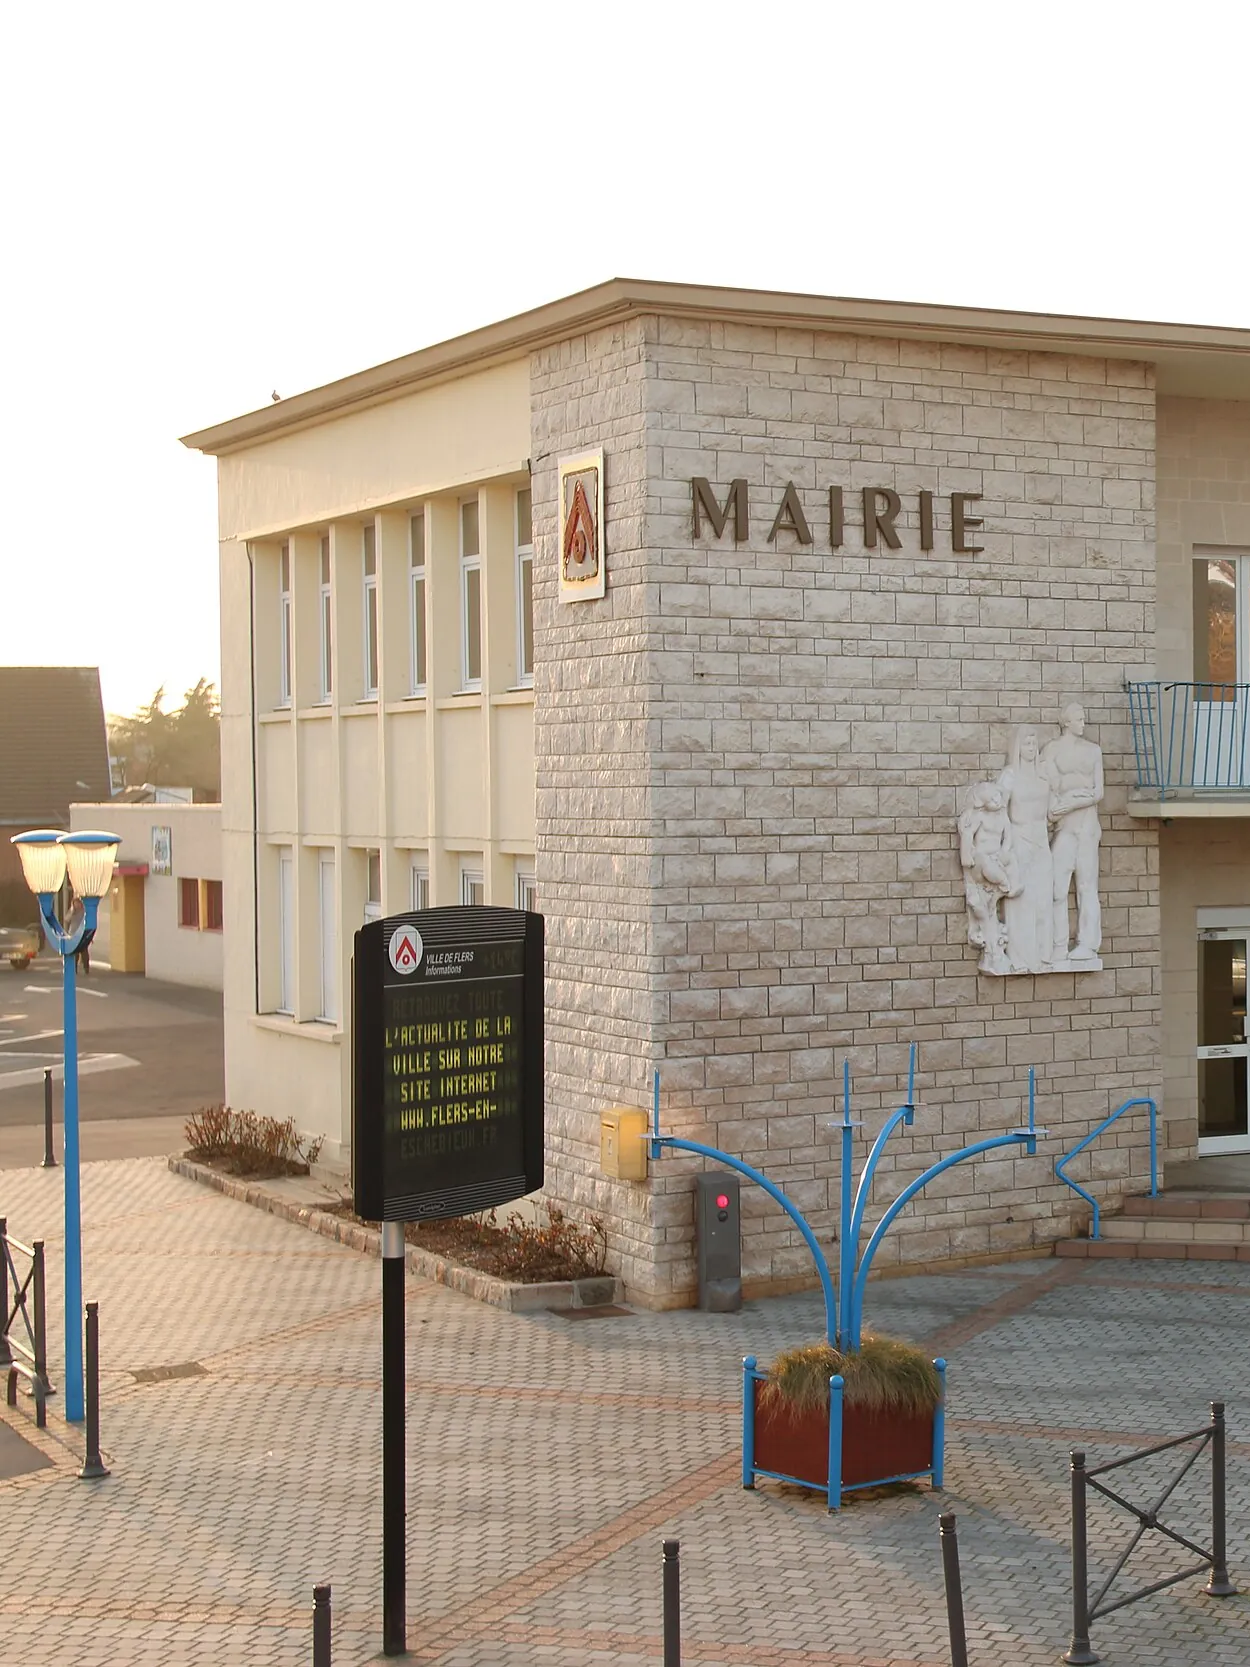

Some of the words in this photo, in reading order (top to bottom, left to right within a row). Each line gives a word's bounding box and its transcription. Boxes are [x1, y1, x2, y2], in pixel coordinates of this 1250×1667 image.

[691, 476, 985, 553] MAIRIE
[425, 965, 462, 976] Informations
[426, 954, 444, 964] VILLE
[444, 953, 454, 963] DE
[454, 951, 474, 962] FLERS
[385, 1019, 468, 1048] L'ACTUALITE
[475, 1018, 490, 1038] DE
[496, 1016, 511, 1036] LA
[393, 1052, 431, 1076] VILLE
[438, 1048, 461, 1070] SUR
[468, 1043, 504, 1067] NOTRE
[400, 1079, 431, 1103] SITE
[440, 1070, 497, 1099] INTERNET
